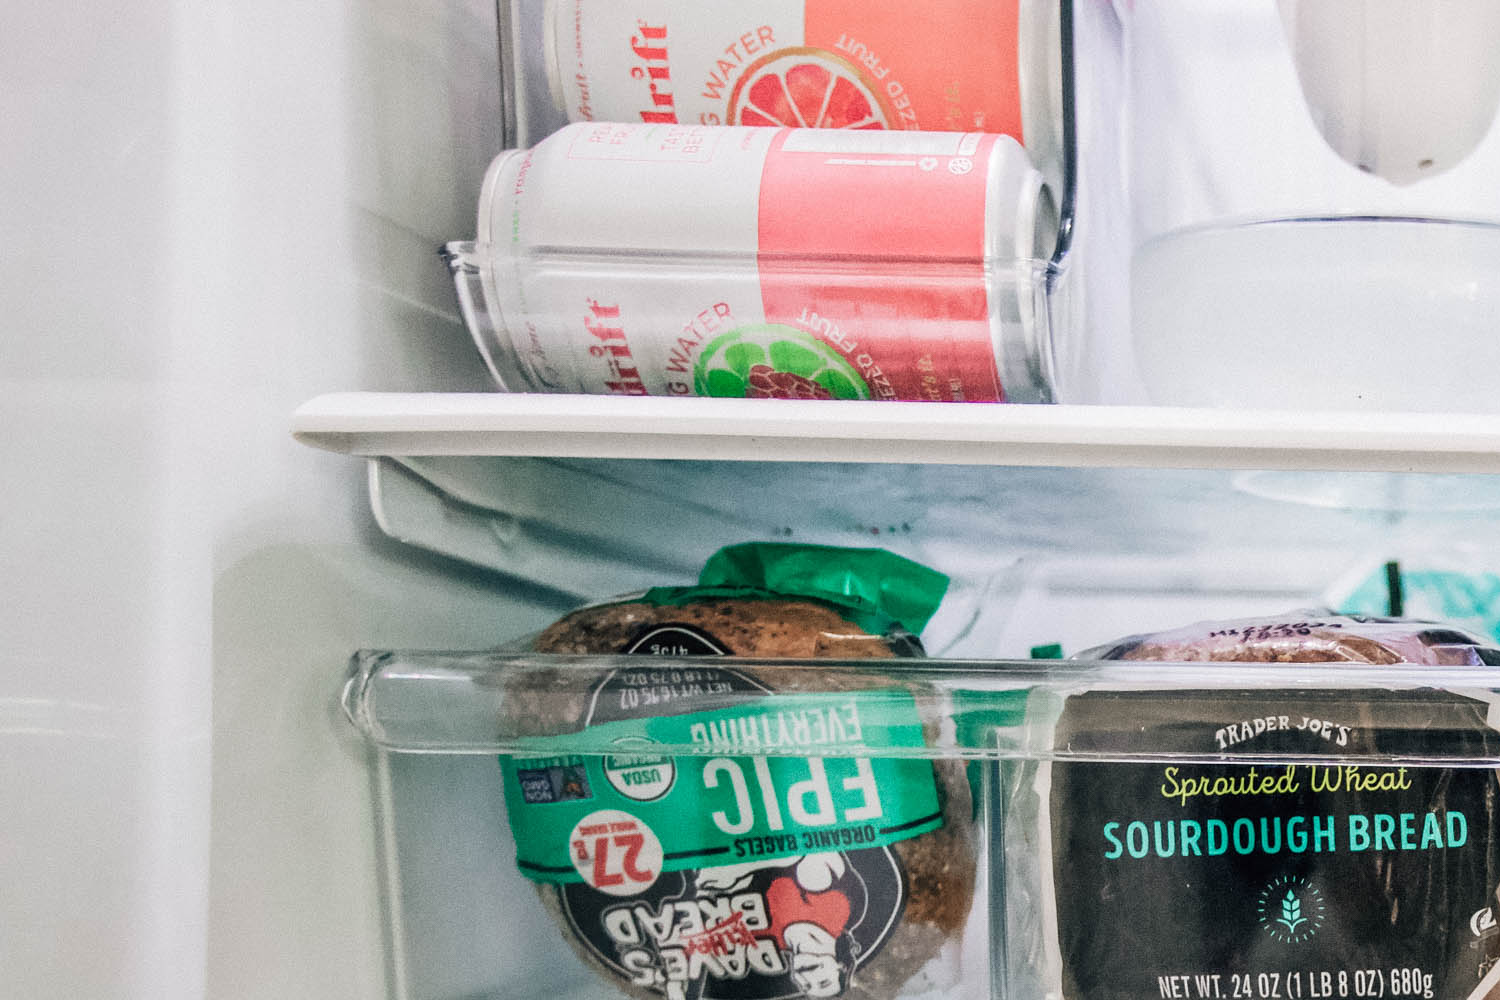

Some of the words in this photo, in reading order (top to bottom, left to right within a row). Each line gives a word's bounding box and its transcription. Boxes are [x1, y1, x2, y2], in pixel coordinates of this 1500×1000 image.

[702, 25, 776, 100] WATER
[833, 33, 891, 80] FRUIT
[665, 302, 735, 373] WATER
[795, 307, 857, 354] FRUIT
[690, 698, 863, 750] EVERYTHING
[1215, 715, 1291, 750] TRADER
[1296, 716, 1352, 748] JOE'S
[621, 769, 661, 786] USDA
[702, 756, 883, 834] EPIC
[1161, 763, 1300, 805] Sprouted
[1305, 764, 1412, 793] Wheat
[733, 832, 796, 858] BAGELS
[801, 823, 876, 848] ORGANIC
[1103, 814, 1336, 860] SOURDOUGH
[1349, 810, 1469, 854] BREAD
[603, 892, 768, 943] BREAD
[623, 936, 788, 990] DAVE'S
[1158, 975, 1191, 999] NET
[1195, 974, 1227, 999] WT.
[1231, 973, 1251, 998] 24
[1258, 972, 1281, 998] OZ
[1286, 971, 1300, 1000] (1
[1309, 971, 1333, 998] LB
[1338, 970, 1348, 997] 8
[1354, 969, 1384, 998] OZ)
[1390, 967, 1434, 999] 680g
